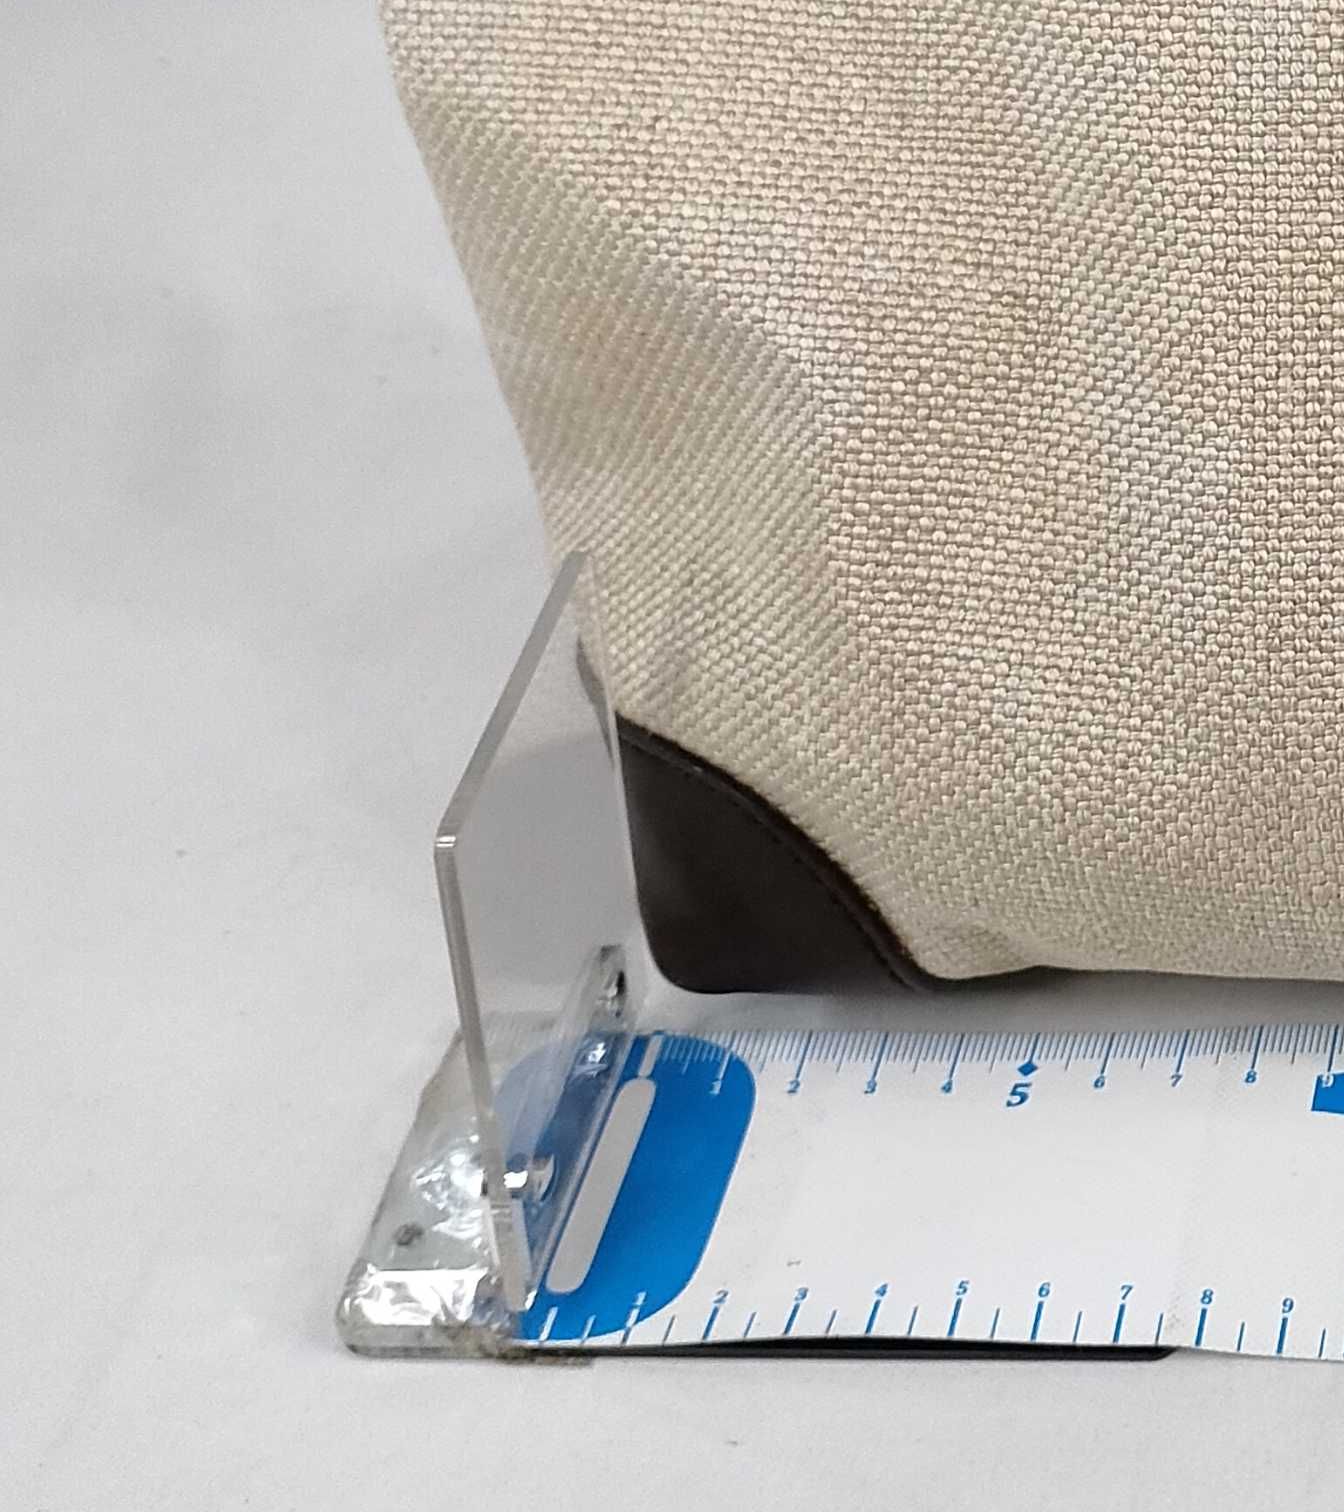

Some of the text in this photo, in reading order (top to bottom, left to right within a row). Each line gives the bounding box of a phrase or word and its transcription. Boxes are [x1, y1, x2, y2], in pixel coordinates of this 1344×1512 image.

[711, 1079, 721, 1095] 1
[787, 1080, 801, 1095] 2
[865, 1080, 877, 1095] 3
[941, 1080, 954, 1094] 4
[1006, 1083, 1032, 1107] 5
[1093, 1074, 1107, 1089] 6
[1170, 1074, 1184, 1088] 7
[1244, 1070, 1258, 1084] 8
[1322, 1074, 1335, 1088] 9
[634, 1292, 647, 1307] 1
[713, 1290, 729, 1303] 2
[794, 1288, 808, 1302] 3
[875, 1283, 889, 1297] 4
[955, 1281, 969, 1296] 5
[1037, 1282, 1050, 1297] 6
[1120, 1285, 1133, 1299] 7
[1201, 1289, 1214, 1304] 8
[1282, 1298, 1295, 1313] 9
